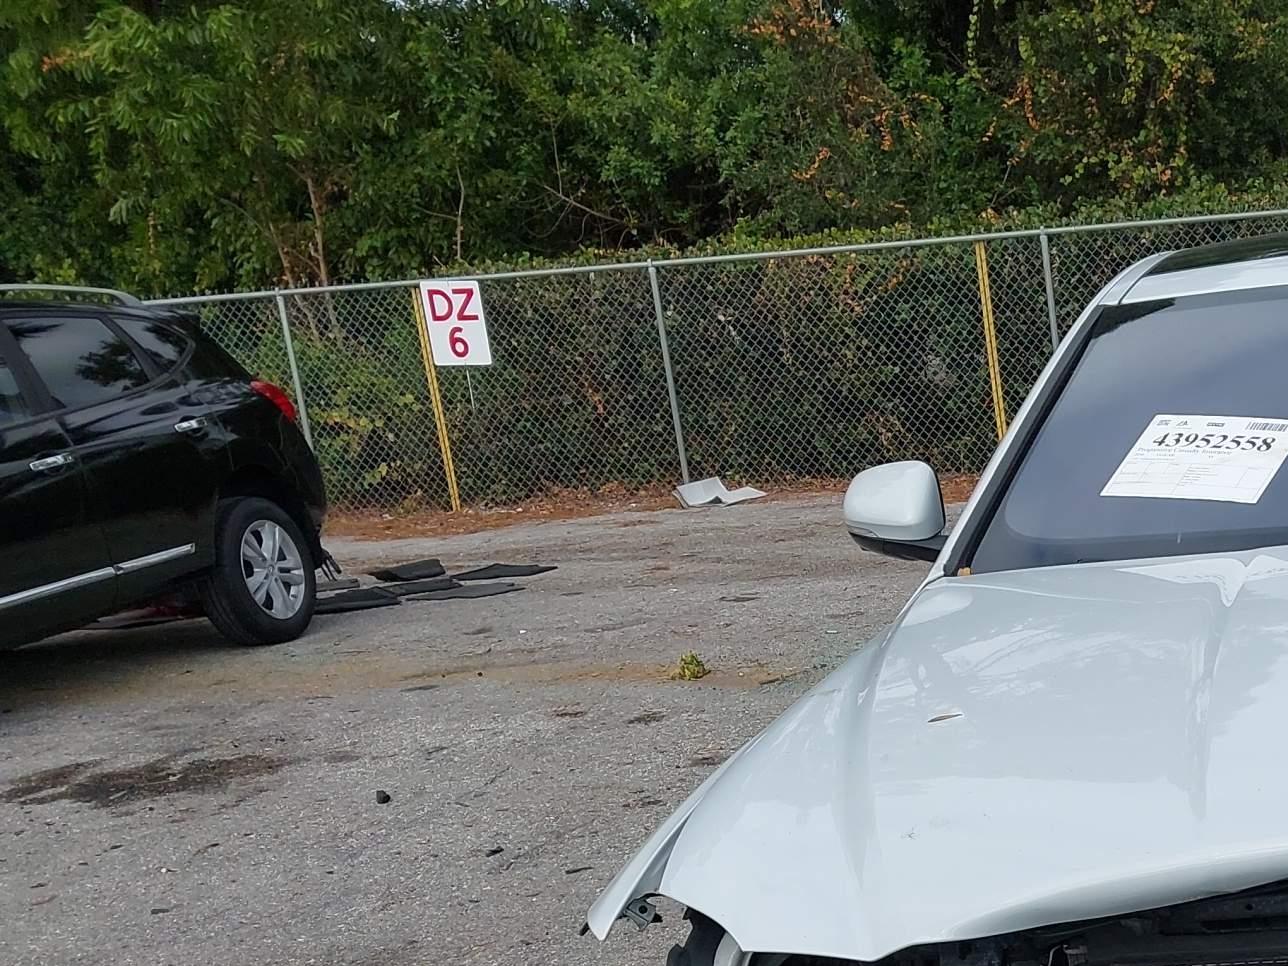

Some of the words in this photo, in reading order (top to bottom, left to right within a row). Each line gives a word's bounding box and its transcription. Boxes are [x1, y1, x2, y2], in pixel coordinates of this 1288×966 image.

[427, 288, 479, 321] DZ
[449, 326, 469, 358] 6
[1152, 431, 1276, 453] 43952558
